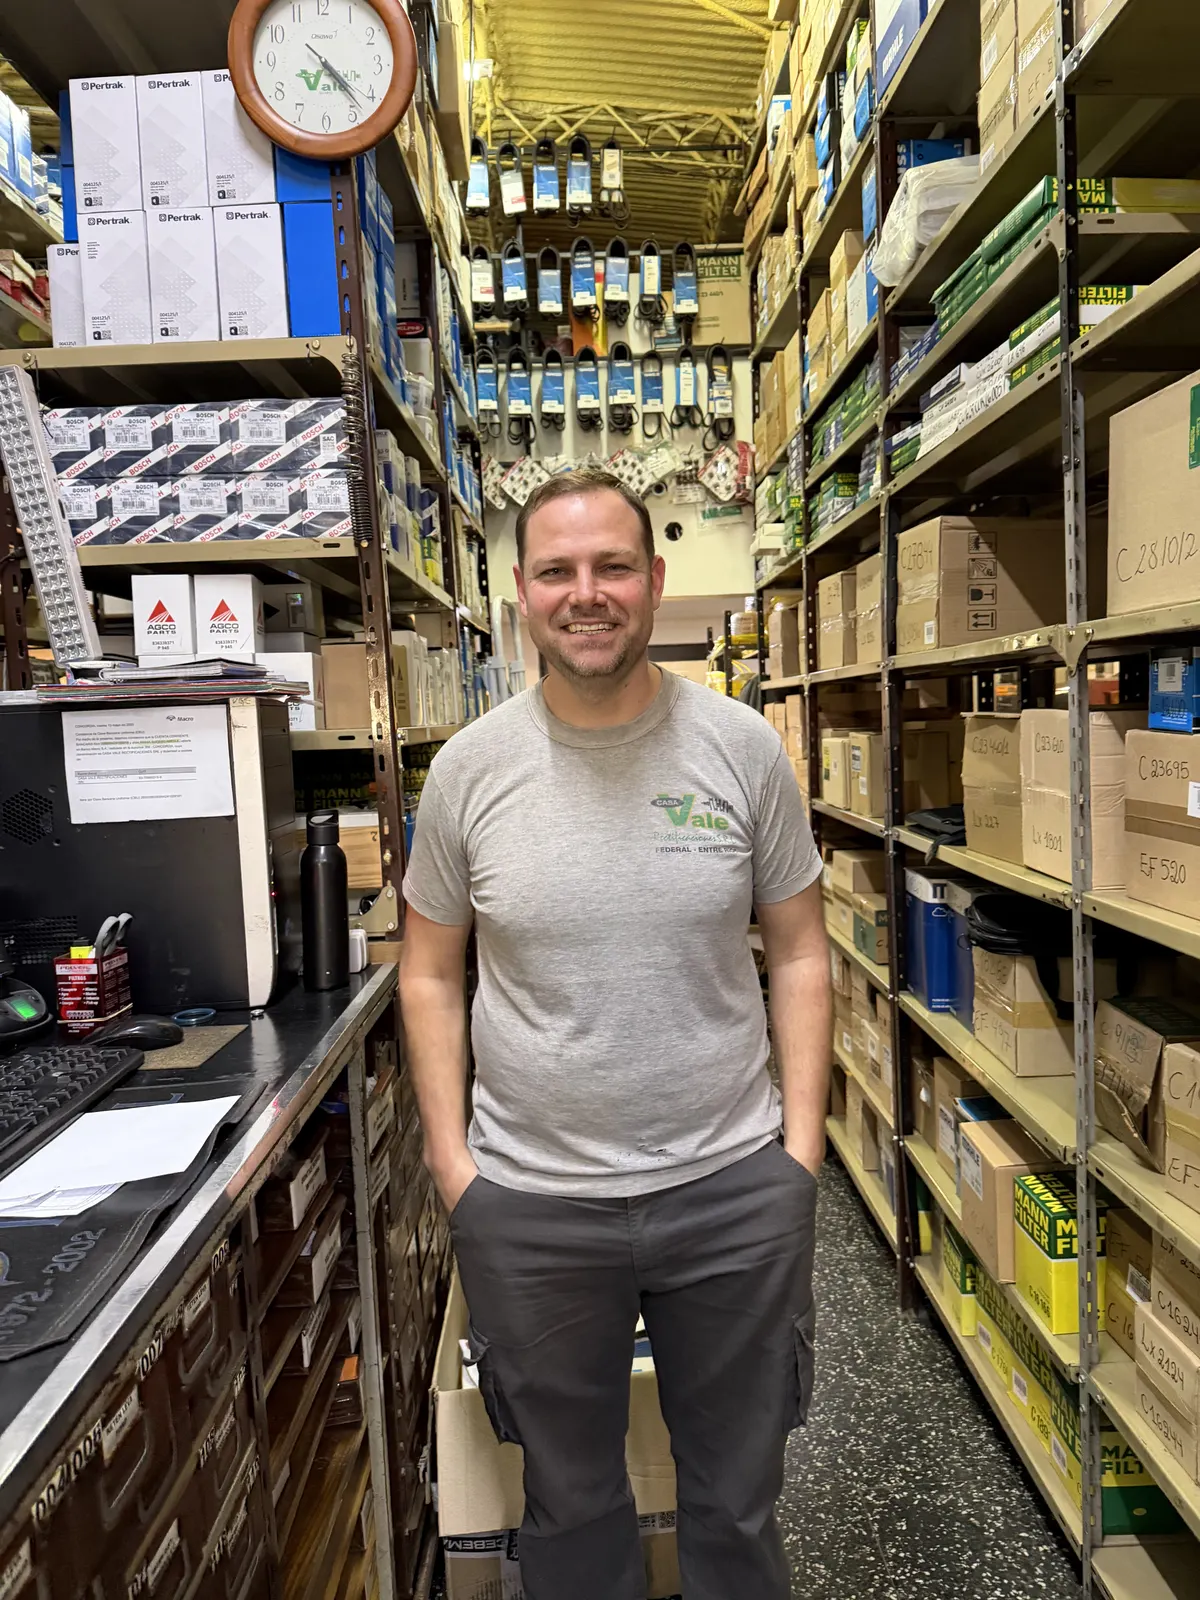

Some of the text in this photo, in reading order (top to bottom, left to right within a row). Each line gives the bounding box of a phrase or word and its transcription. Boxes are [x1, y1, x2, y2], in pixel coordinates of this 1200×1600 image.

[292, 4, 302, 23] 11
[317, 0, 329, 15] 12
[270, 24, 285, 44] 10
[365, 27, 376, 46] 2
[266, 51, 277, 72] 9
[373, 54, 383, 75] 3
[90, 81, 124, 90] Pertrak
[157, 79, 190, 88] Pertrak
[274, 81, 285, 101] 8
[367, 84, 376, 102] 4
[295, 103, 304, 121] 7
[321, 111, 331, 130] 6
[348, 104, 358, 123] 5
[96, 216, 130, 226] Pertrak
[167, 213, 201, 222] Pertrak
[235, 211, 269, 220] Pertrak
[697, 257, 738, 266] MANN
[697, 266, 738, 276] FILTER
[301, 424, 324, 441] BOSCH
[66, 461, 88, 478] BOSCH
[129, 458, 152, 476] BOSCH
[193, 454, 216, 471] BOSCH
[258, 452, 281, 469] BOSCH
[135, 527, 158, 545] BOSCH
[200, 525, 223, 542] BOSCH
[656, 793, 729, 831] Vale
[1160, 858, 1187, 885] 520
[1014, 1185, 1049, 1234] MANN
[1014, 1206, 1049, 1256] FILTER
[1100, 1446, 1138, 1460] MA
[1100, 1461, 1145, 1475] FILT
